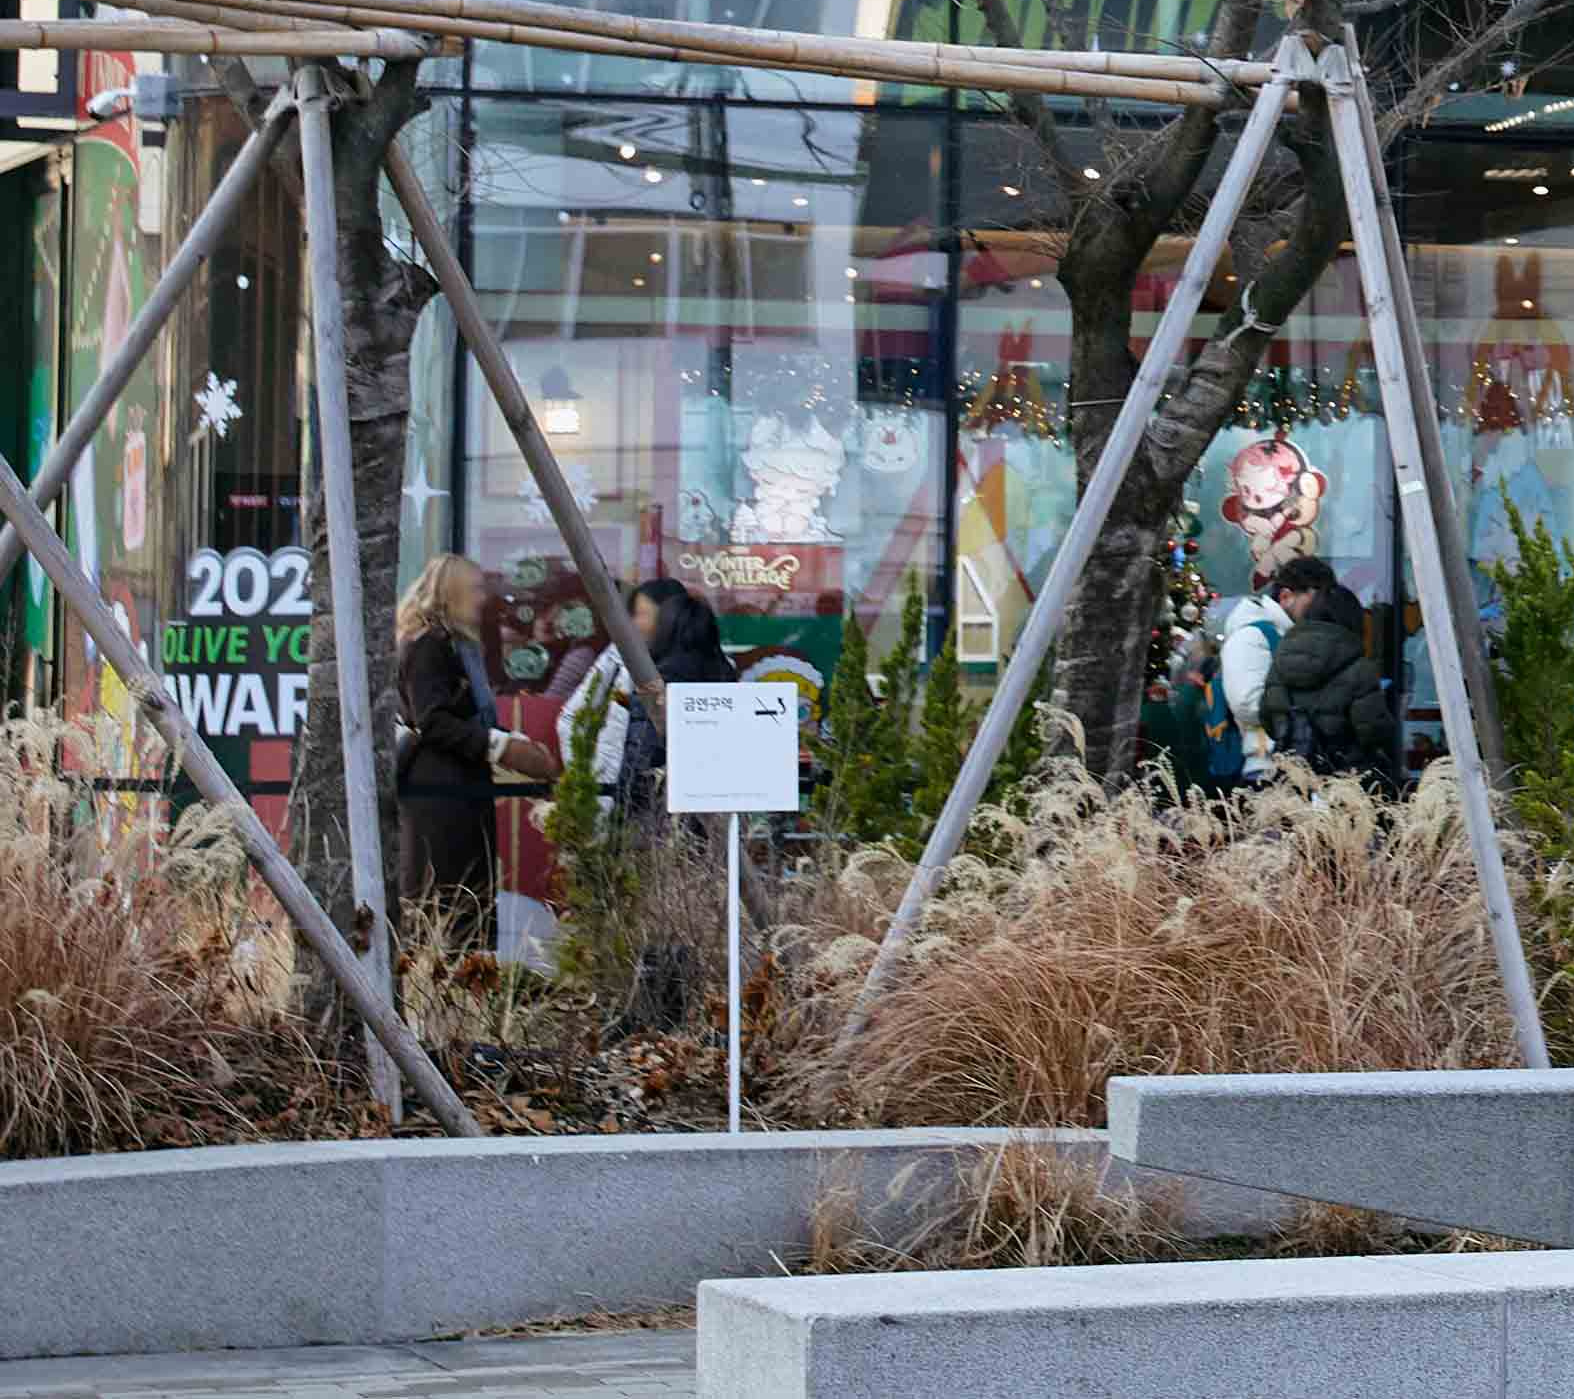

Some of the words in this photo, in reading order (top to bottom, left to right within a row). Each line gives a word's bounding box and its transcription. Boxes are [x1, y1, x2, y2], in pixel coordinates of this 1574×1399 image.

[186, 546, 315, 618] 202
[162, 624, 249, 664] OLIVE
[153, 673, 310, 736] WAR
